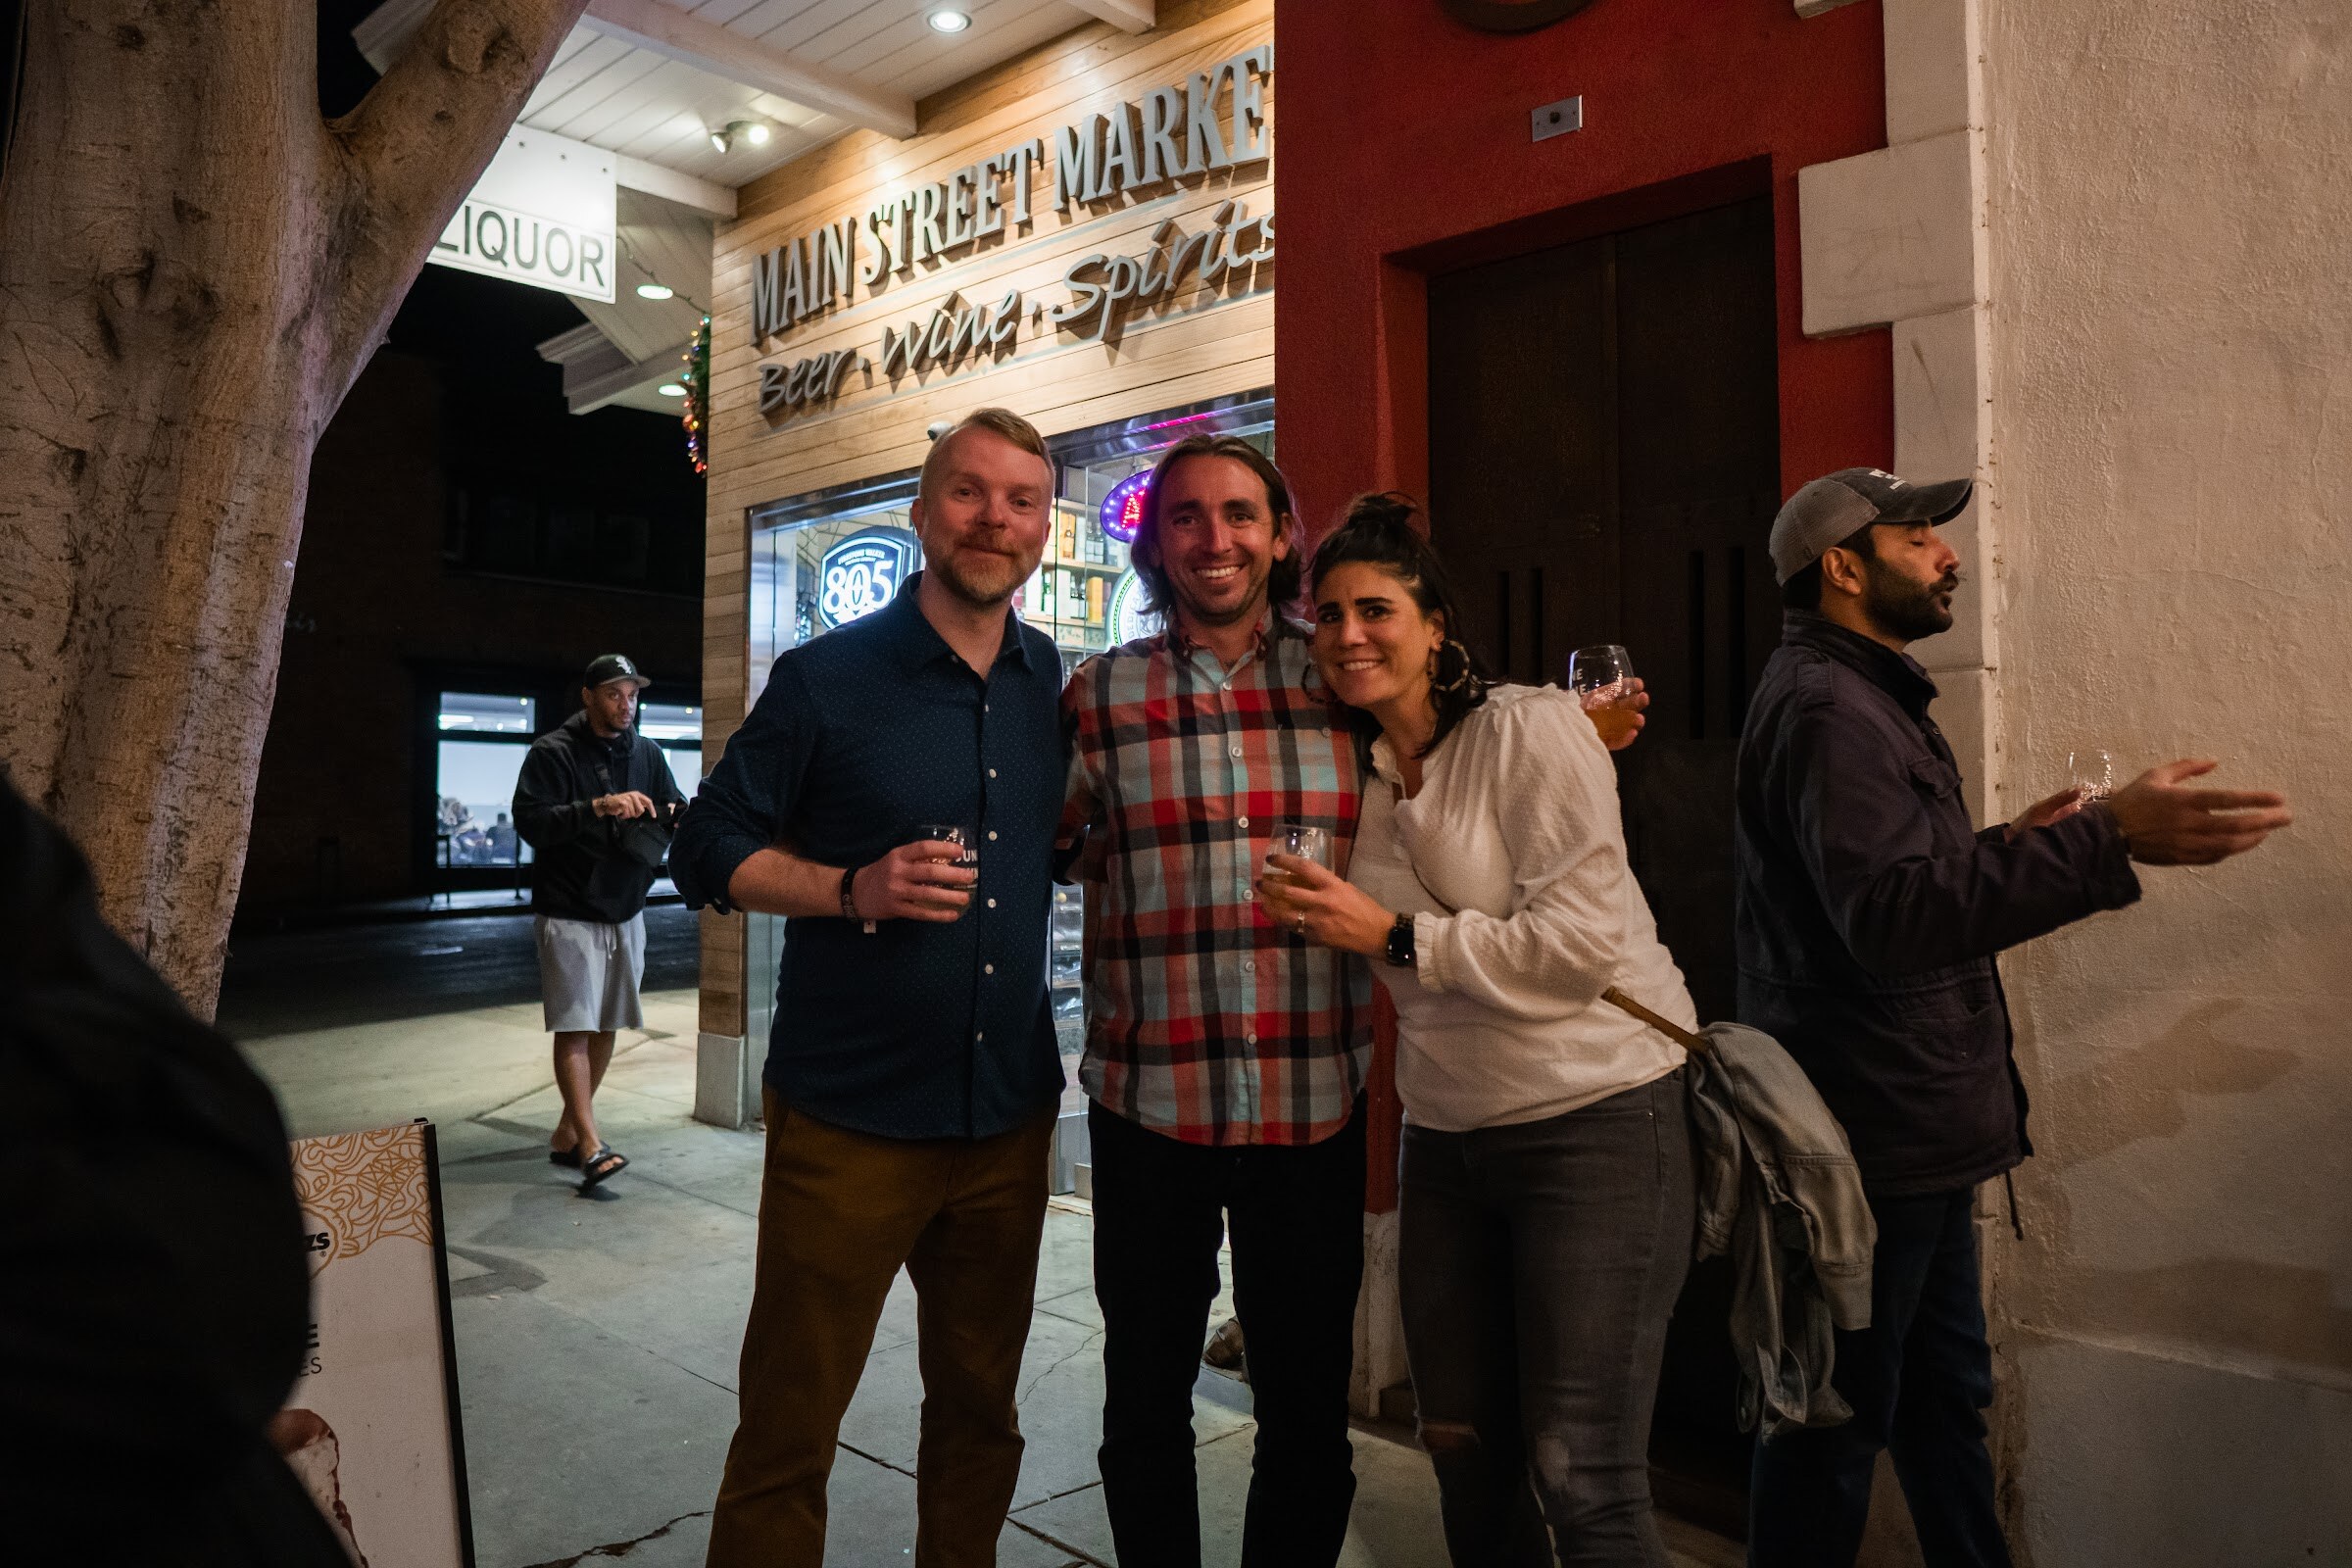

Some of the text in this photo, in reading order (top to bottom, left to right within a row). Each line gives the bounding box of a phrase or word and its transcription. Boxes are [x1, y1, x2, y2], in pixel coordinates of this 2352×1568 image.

[752, 40, 1274, 345] MAIN STREET MARKE
[759, 348, 856, 413] Beer
[1050, 198, 1274, 341] Spirits
[823, 561, 894, 613] 805
